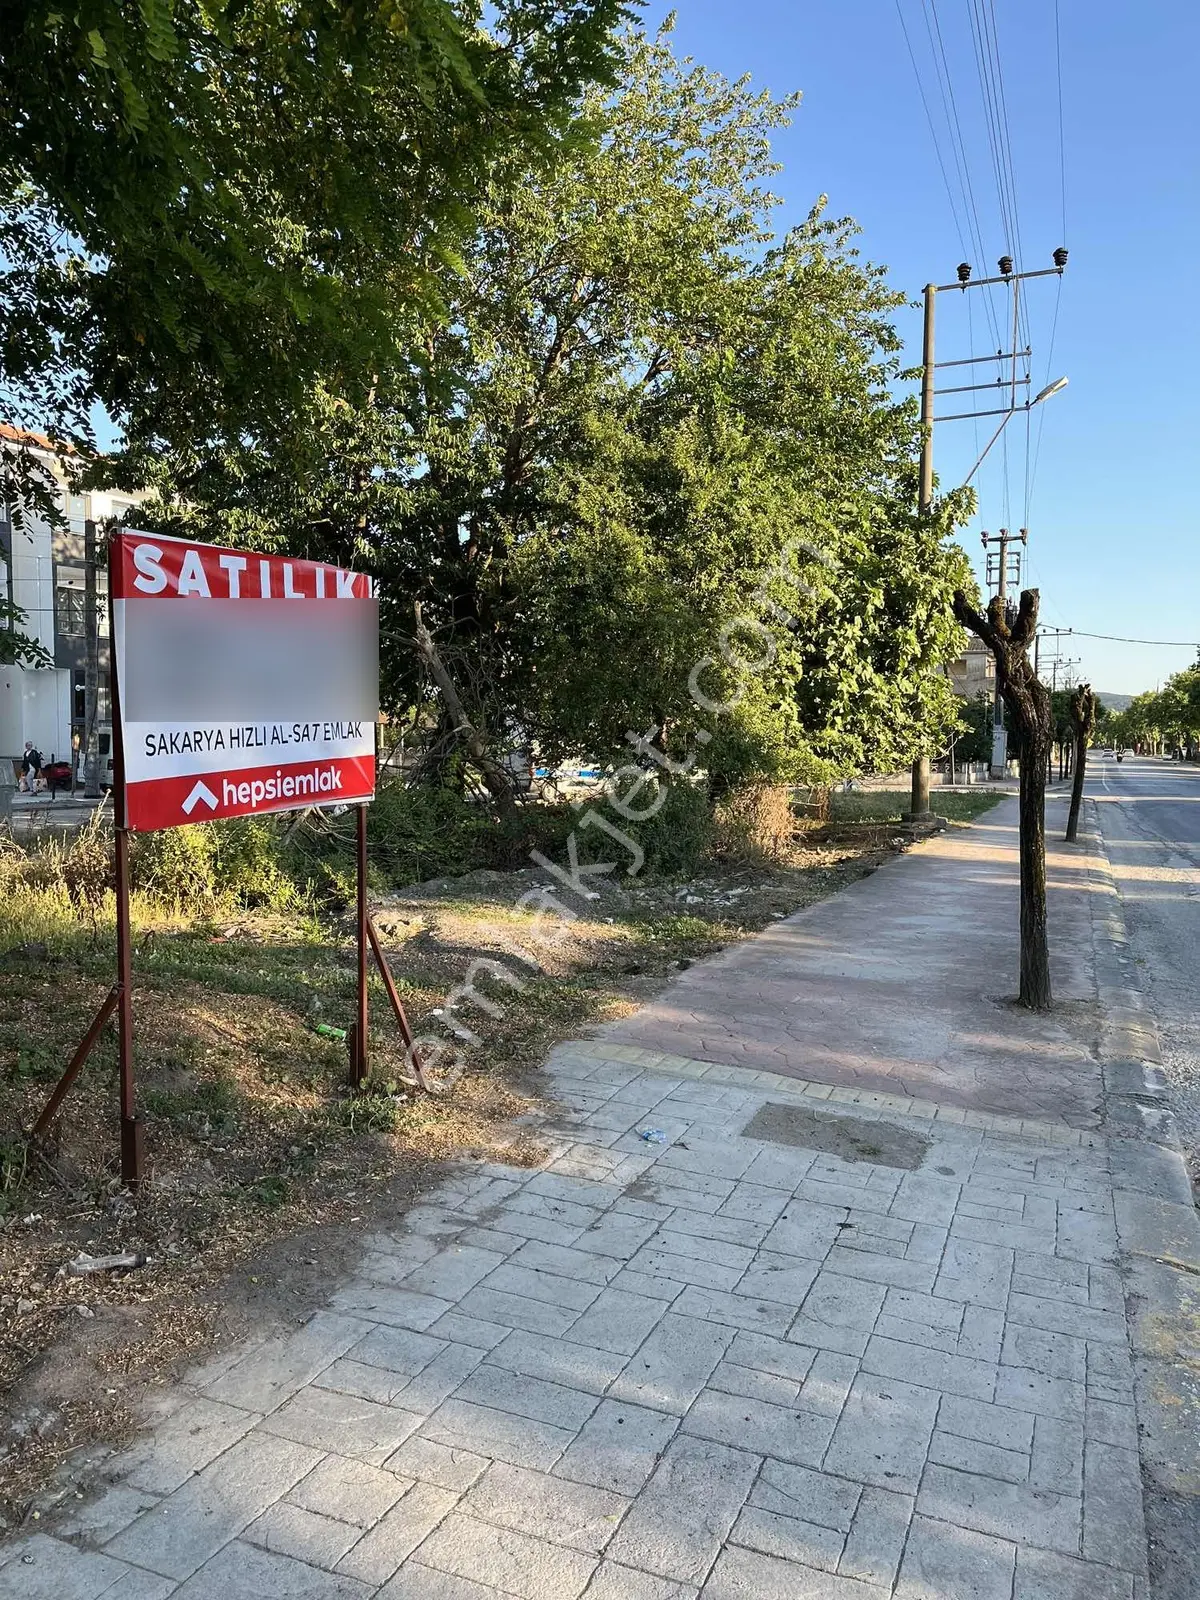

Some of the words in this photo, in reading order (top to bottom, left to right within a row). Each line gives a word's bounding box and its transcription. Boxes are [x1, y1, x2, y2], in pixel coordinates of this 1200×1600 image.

[132, 543, 358, 599] SATILIK
[145, 729, 225, 757] SAKARYA
[229, 726, 267, 749] HIZLI
[270, 722, 321, 745] AL-SAT
[323, 721, 363, 742] EMLAK
[222, 765, 343, 808] hepsiemlak
